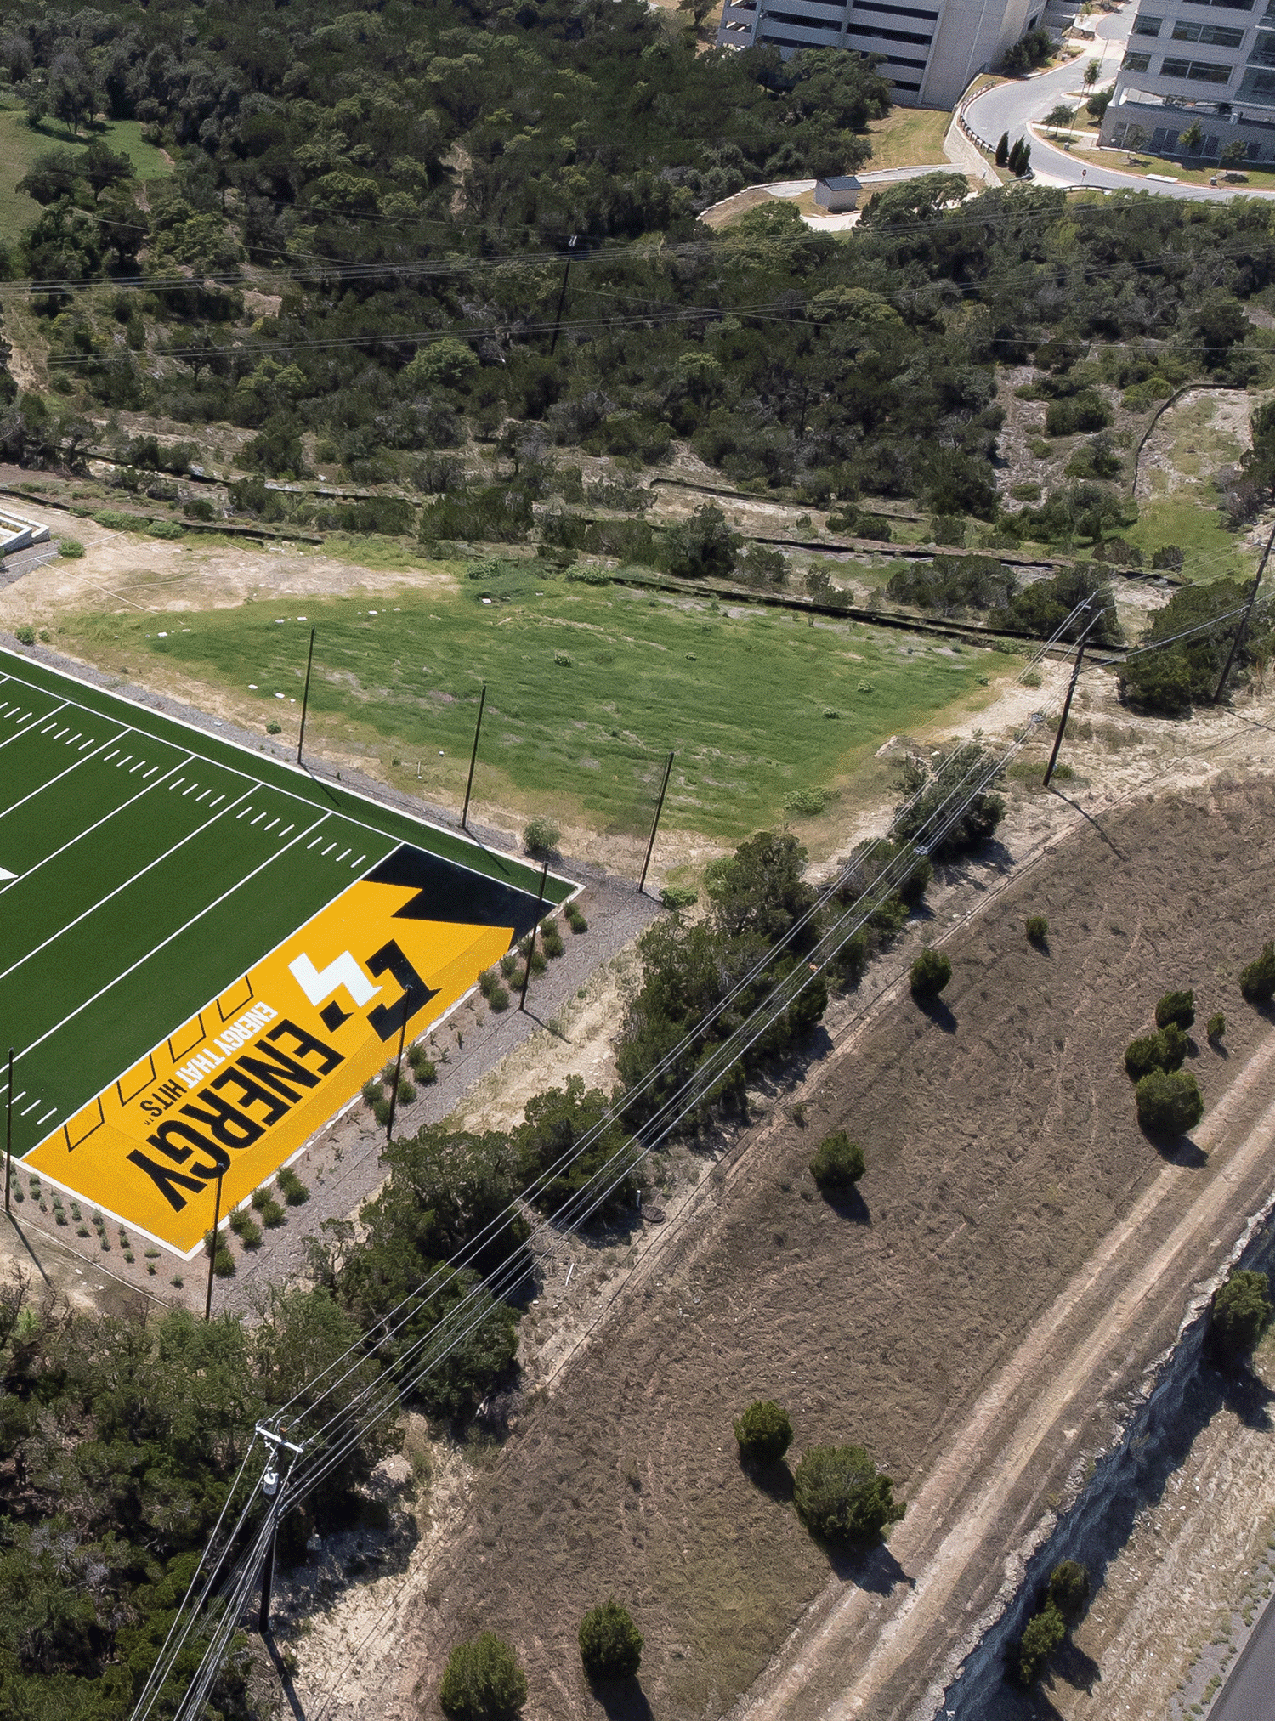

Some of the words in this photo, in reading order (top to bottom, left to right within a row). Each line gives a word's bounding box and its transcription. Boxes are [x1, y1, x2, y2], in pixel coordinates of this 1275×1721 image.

[213, 1001, 279, 1057] ENERGY
[175, 1048, 226, 1090] THAT
[126, 1020, 346, 1213] ENERGY
